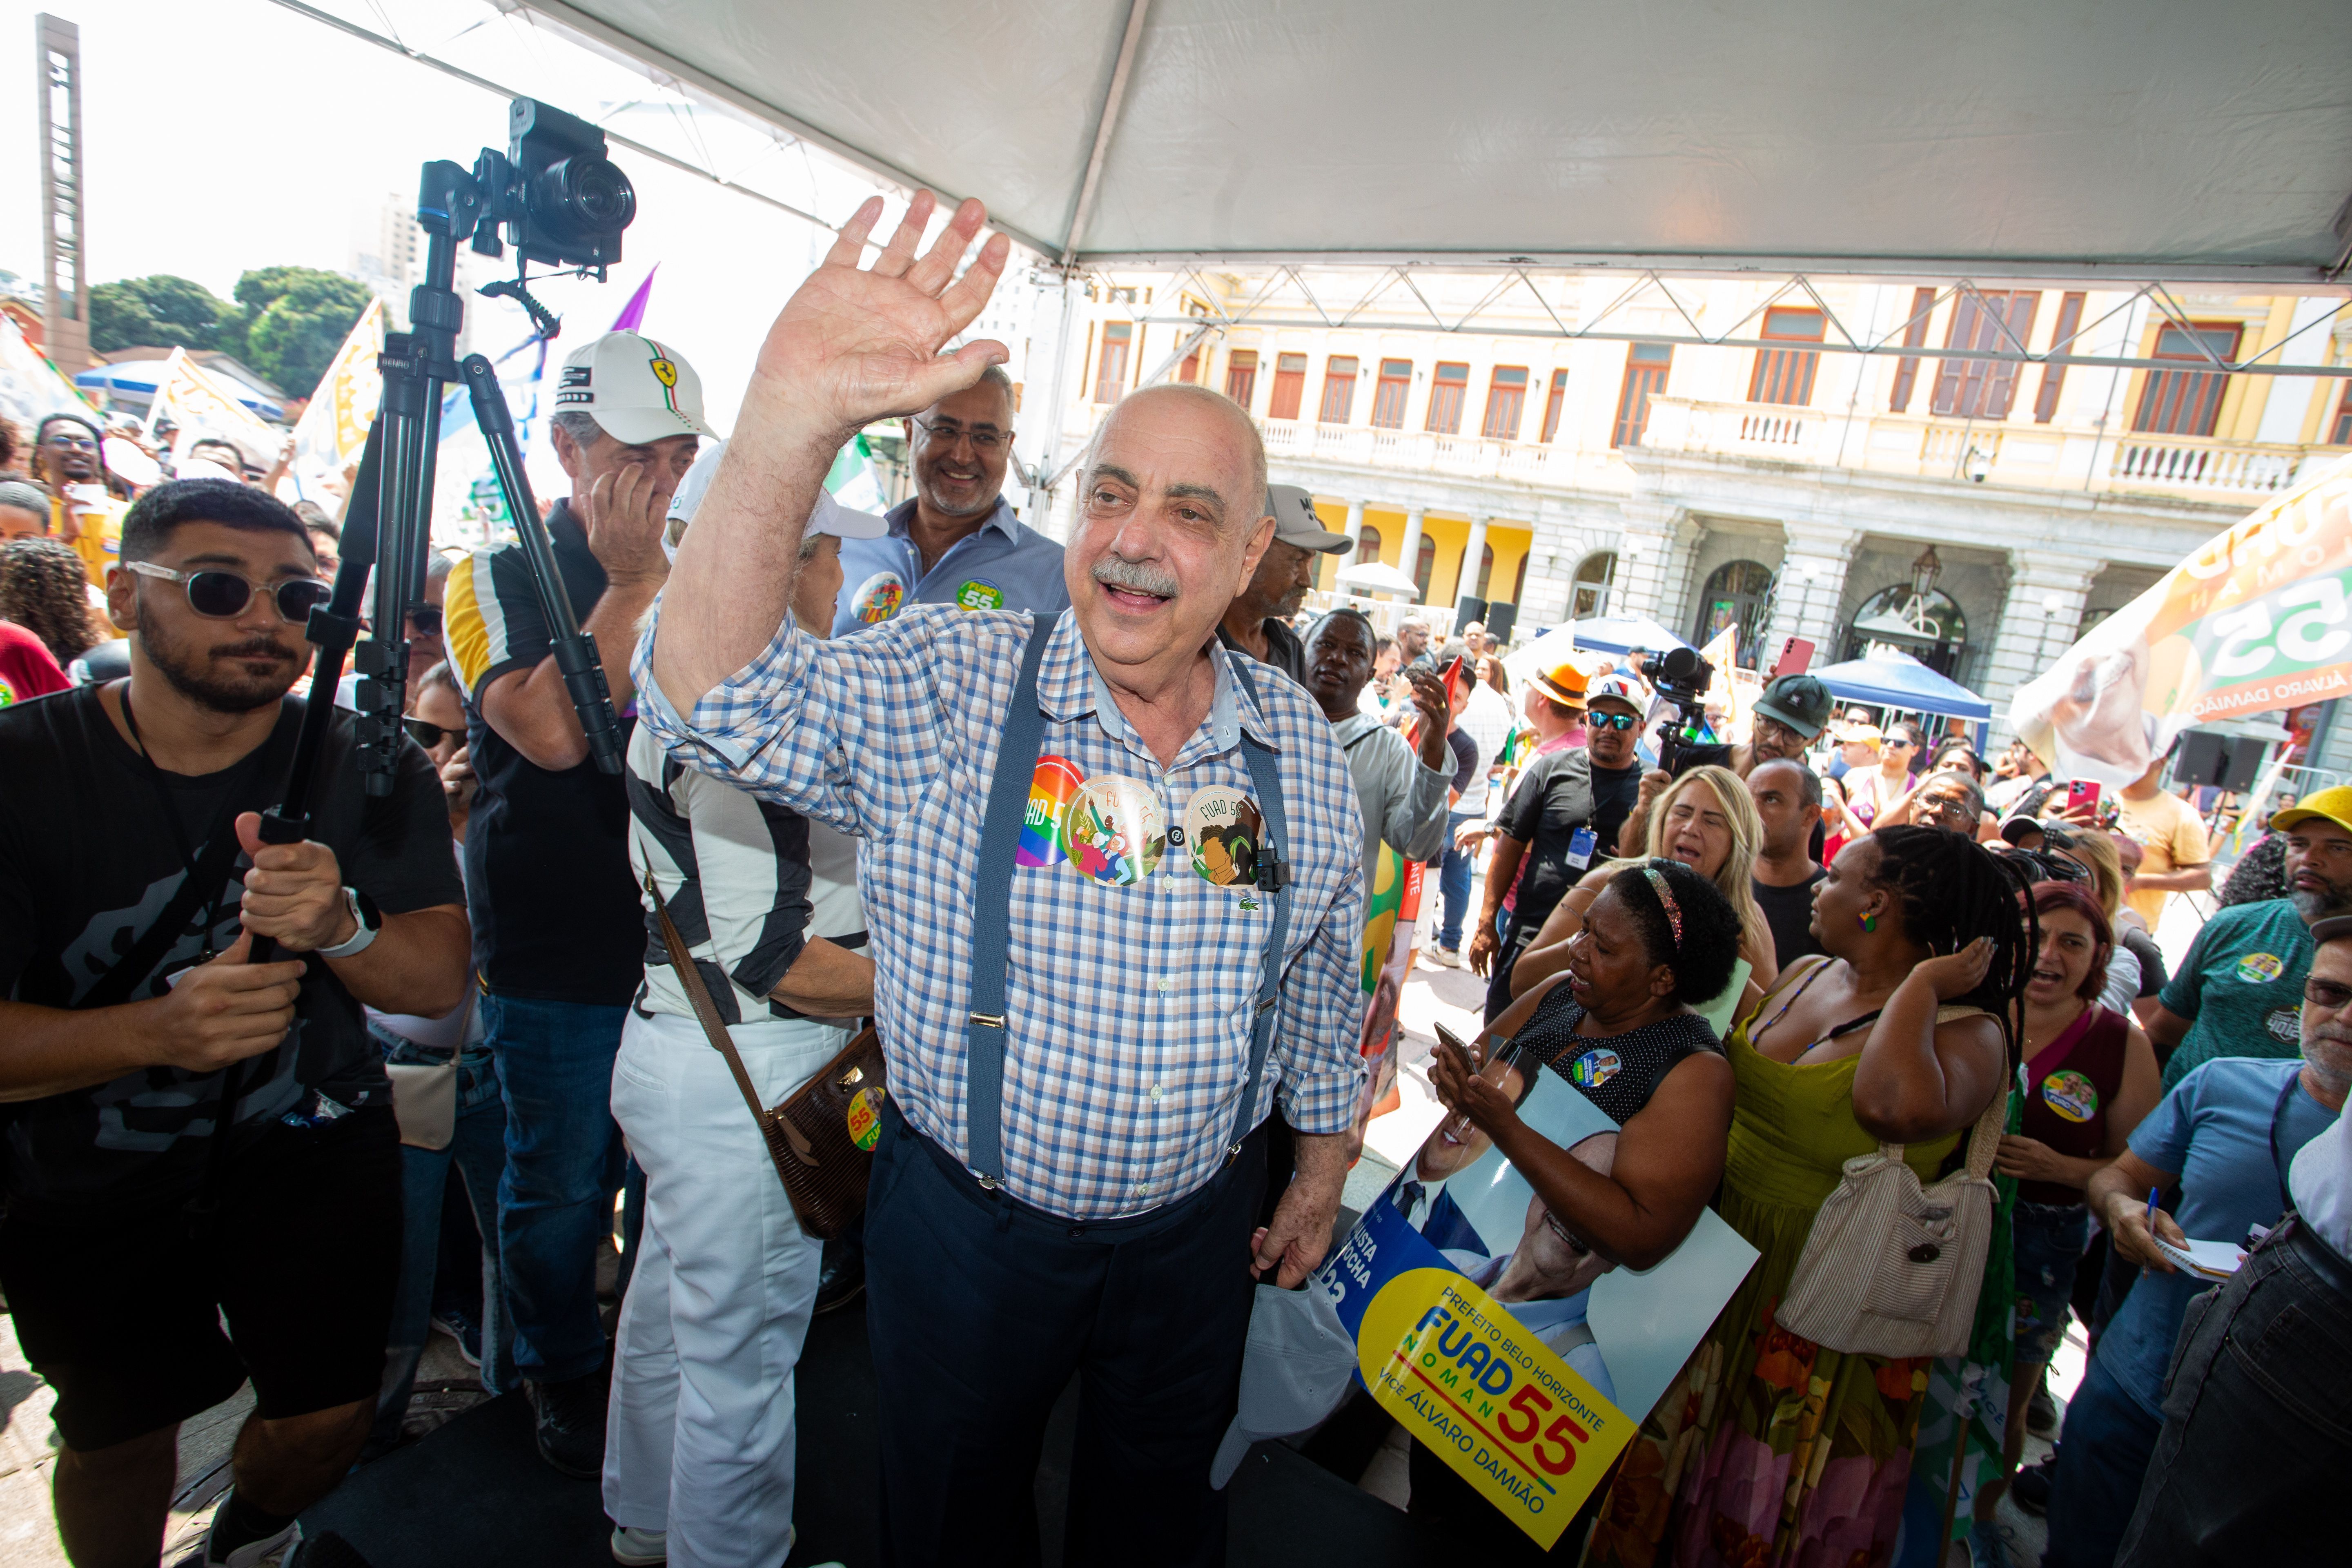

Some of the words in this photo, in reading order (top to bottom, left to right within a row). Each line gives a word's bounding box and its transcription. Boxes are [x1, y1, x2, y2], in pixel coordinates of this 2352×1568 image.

[963, 590, 994, 610] 55
[968, 582, 998, 597] FUAD
[1200, 799, 1227, 821] FUAD
[1230, 801, 1244, 819] 55
[850, 1107, 870, 1131] 55
[1402, 1334, 1494, 1418] NOMAN
[1416, 1306, 1513, 1396] FUAD
[1441, 1286, 1501, 1341] PREFEITO
[1501, 1338, 1533, 1369] BELO
[1532, 1365, 1605, 1432] HORIZONTE
[1379, 1366, 1407, 1396] VICE
[1405, 1390, 1474, 1452] ÁLVARO
[1473, 1447, 1544, 1514] DAMIÃO
[1497, 1383, 1590, 1476] 55
